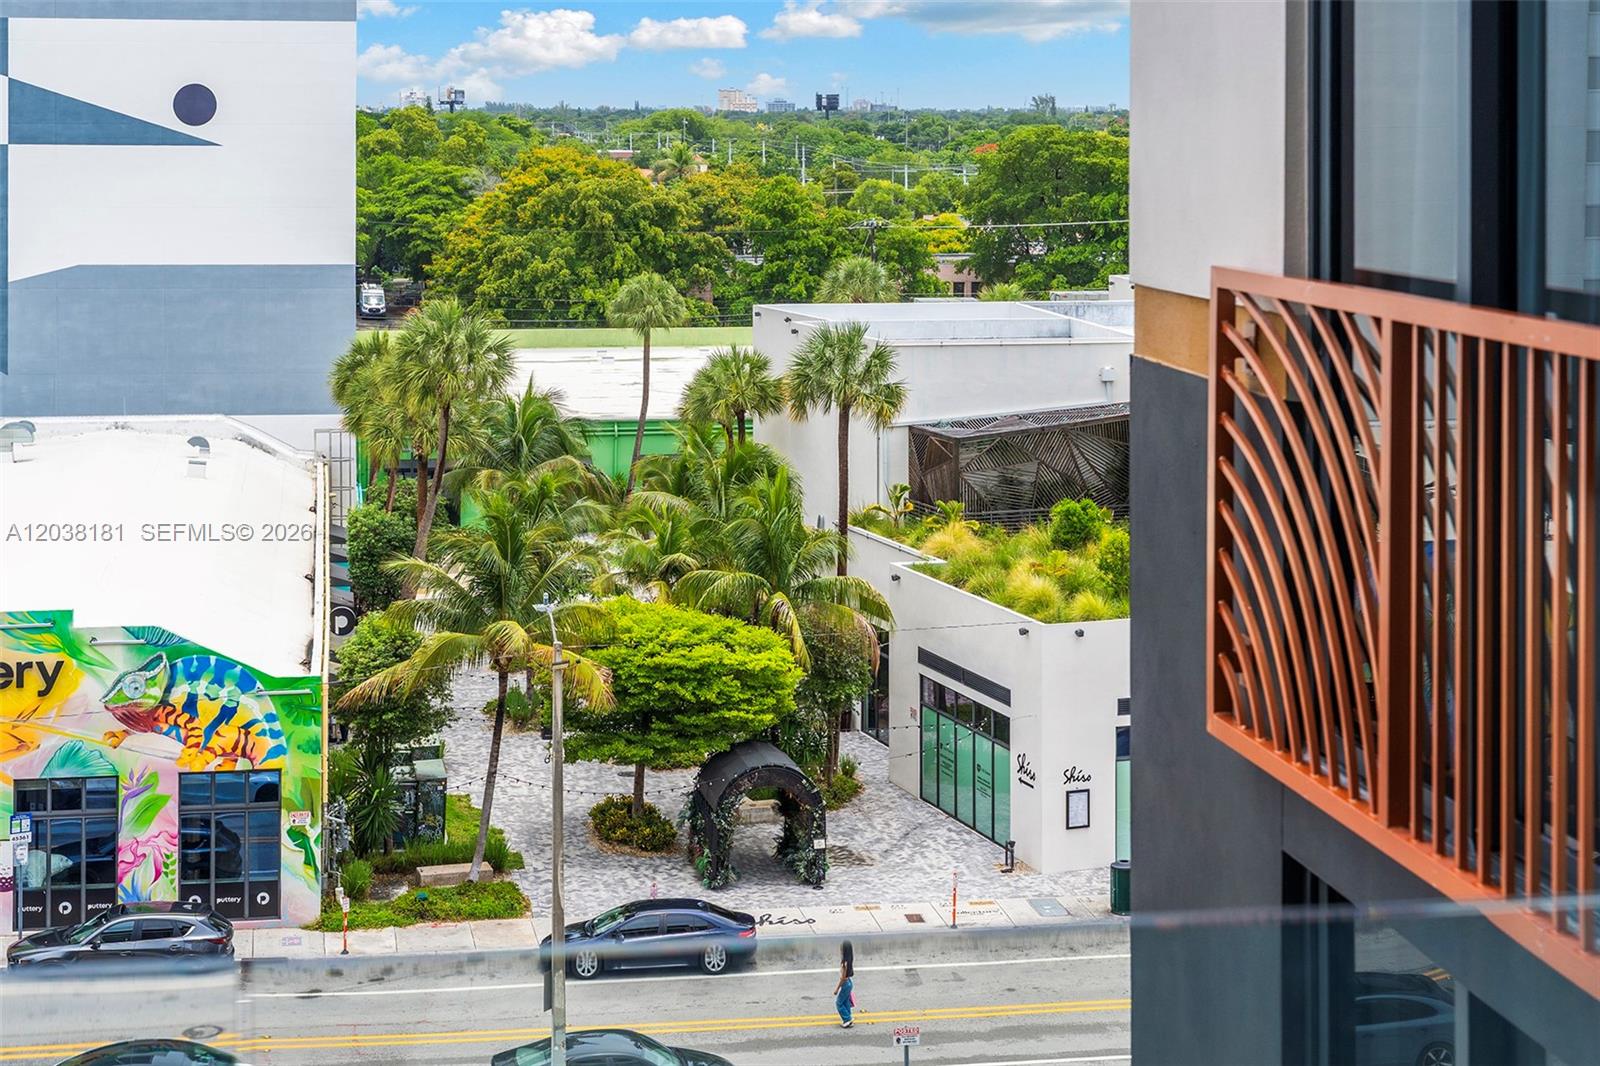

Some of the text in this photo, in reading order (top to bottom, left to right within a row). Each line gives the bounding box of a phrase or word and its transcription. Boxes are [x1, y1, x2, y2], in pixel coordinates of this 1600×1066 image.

[1017, 753, 1036, 781] Shiso
[1063, 766, 1092, 785] Shiso
[216, 896, 242, 904] puttery
[18, 904, 43, 913] uttery
[87, 902, 113, 911] puttery
[755, 913, 817, 927] hiso
